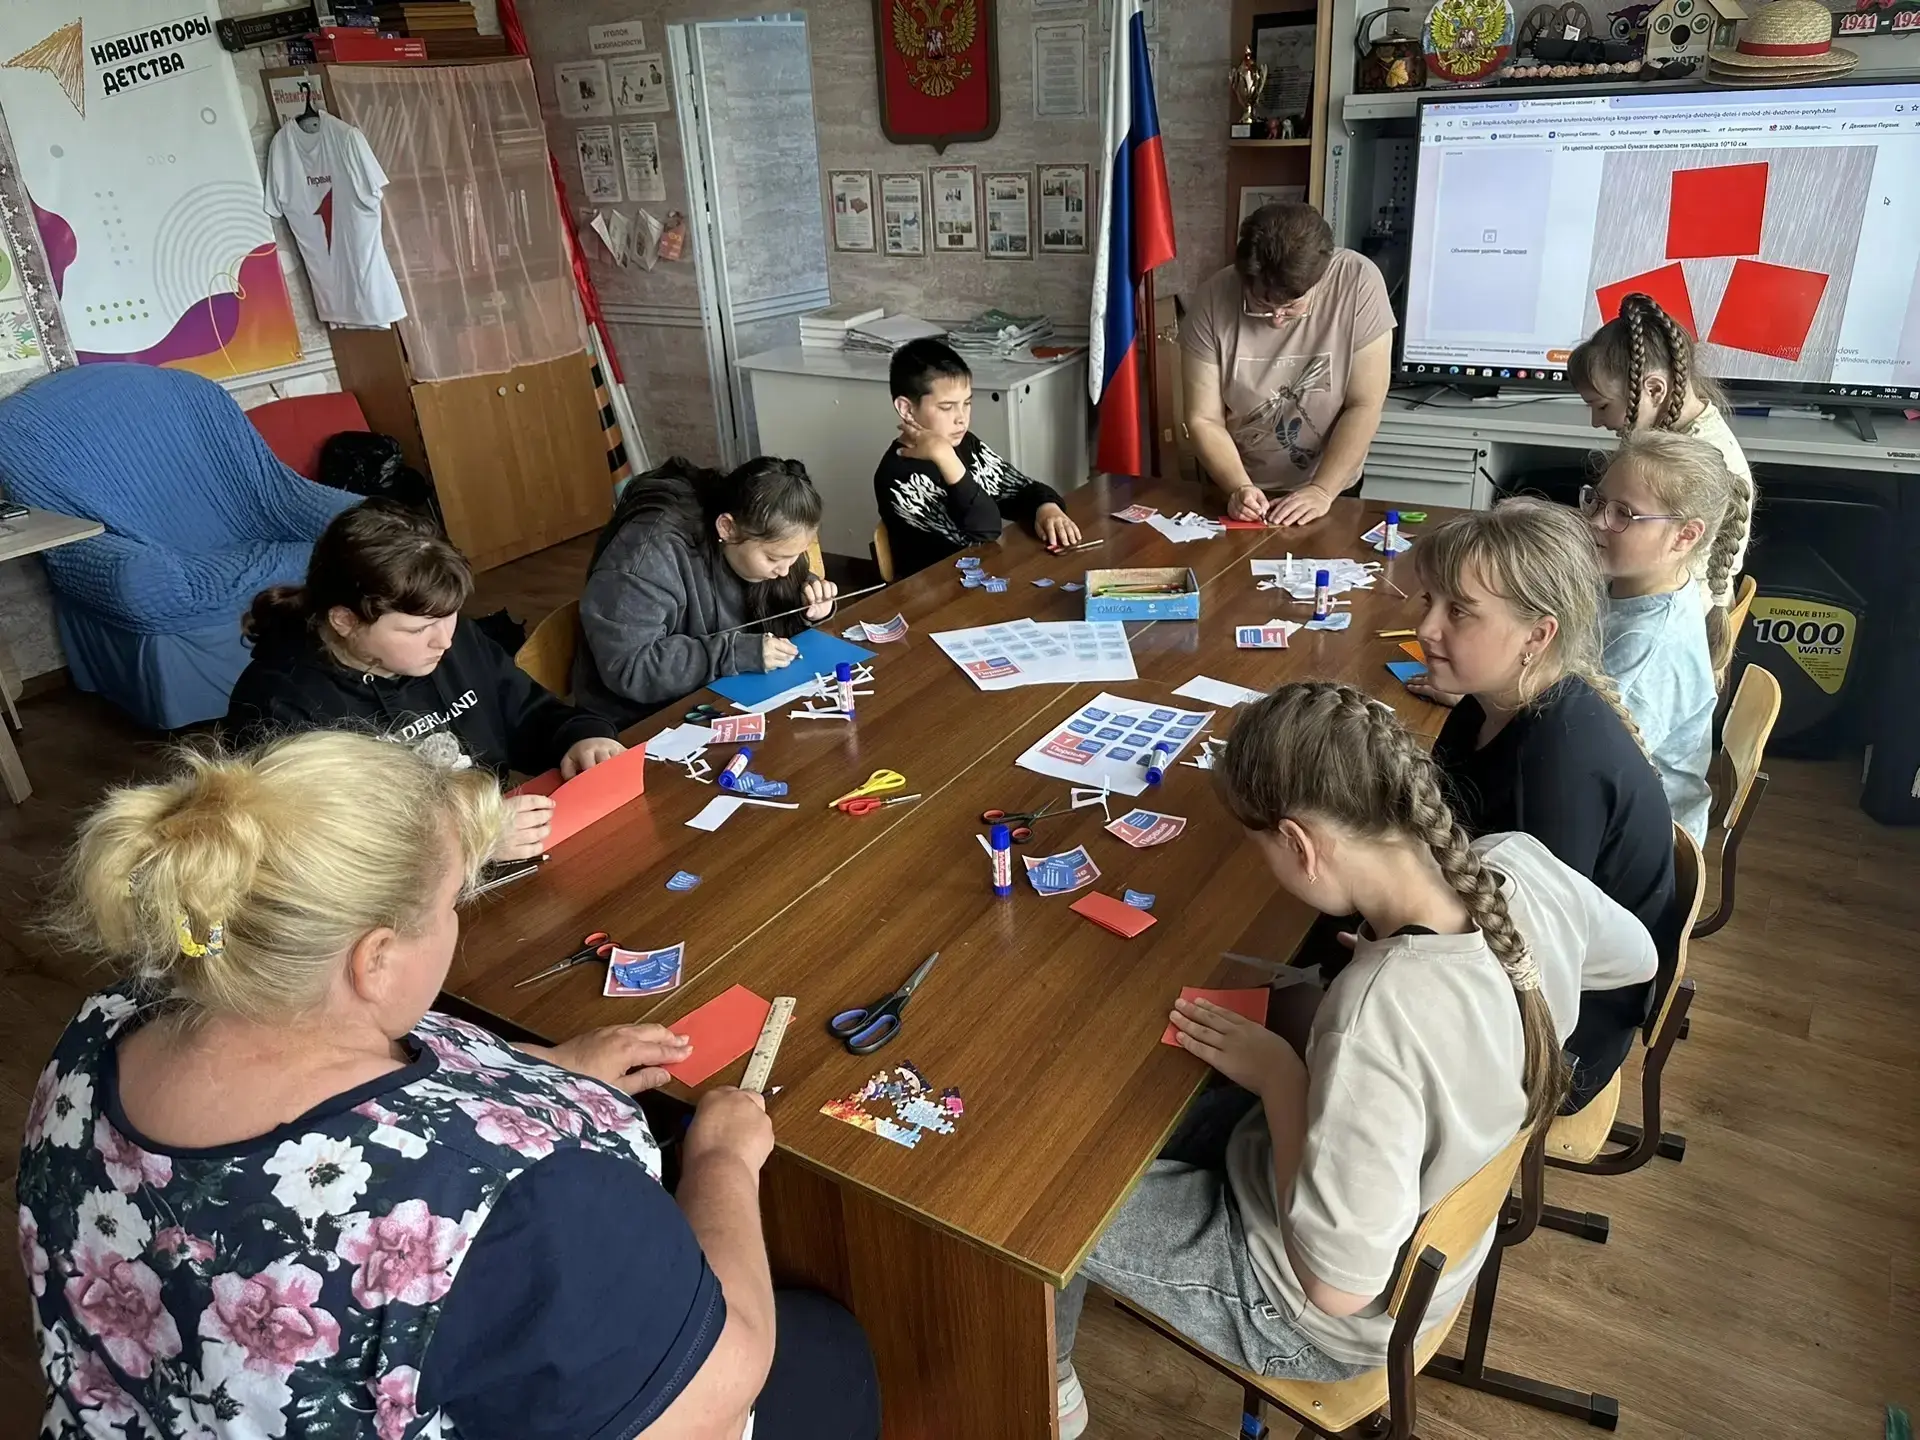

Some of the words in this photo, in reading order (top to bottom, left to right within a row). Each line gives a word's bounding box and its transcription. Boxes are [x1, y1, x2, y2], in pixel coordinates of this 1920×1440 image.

[1839, 13, 1878, 32] 1941
[1892, 11, 1920, 29] 194
[603, 29, 629, 38] УГОЛОК
[90, 15, 212, 65] НАВИГАТОРЫ
[594, 38, 642, 50] БЕЗОПАСНОСТИ
[102, 52, 185, 96] ДЕТСТВА
[1849, 122, 1876, 130] Движение
[1571, 144, 1593, 152] цветной
[1594, 143, 1627, 151] ксероксной
[1627, 143, 1648, 151] бумаги
[1649, 142, 1679, 150] вырезаем
[1680, 142, 1690, 150] три
[1691, 141, 1719, 149] квадрата
[1769, 608, 1811, 618] EUROLIVE
[1753, 618, 1846, 646] 1000
[1798, 645, 1842, 655] WATTS
